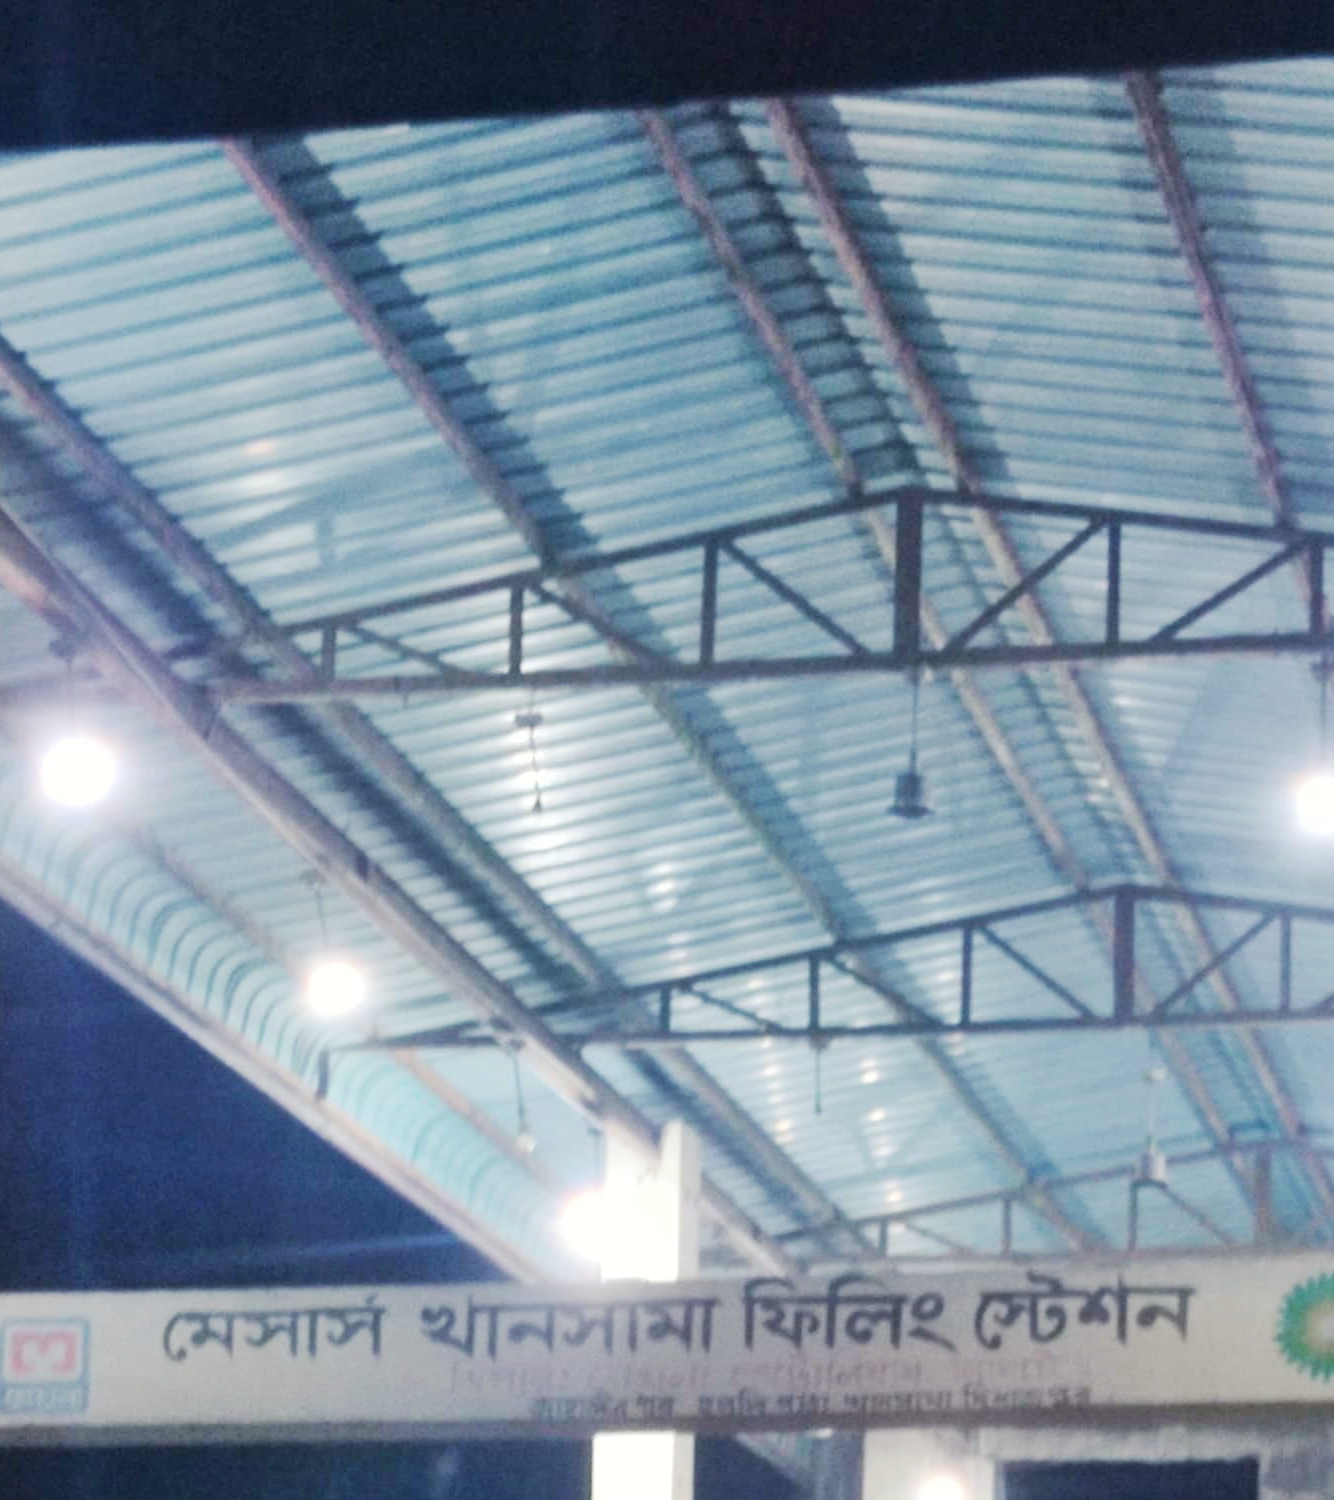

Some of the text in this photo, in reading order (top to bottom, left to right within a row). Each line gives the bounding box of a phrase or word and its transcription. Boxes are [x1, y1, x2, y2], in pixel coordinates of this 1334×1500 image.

[164, 1270, 1196, 1361] মেসার্স খানসামা ফিলিং স্টেশন
